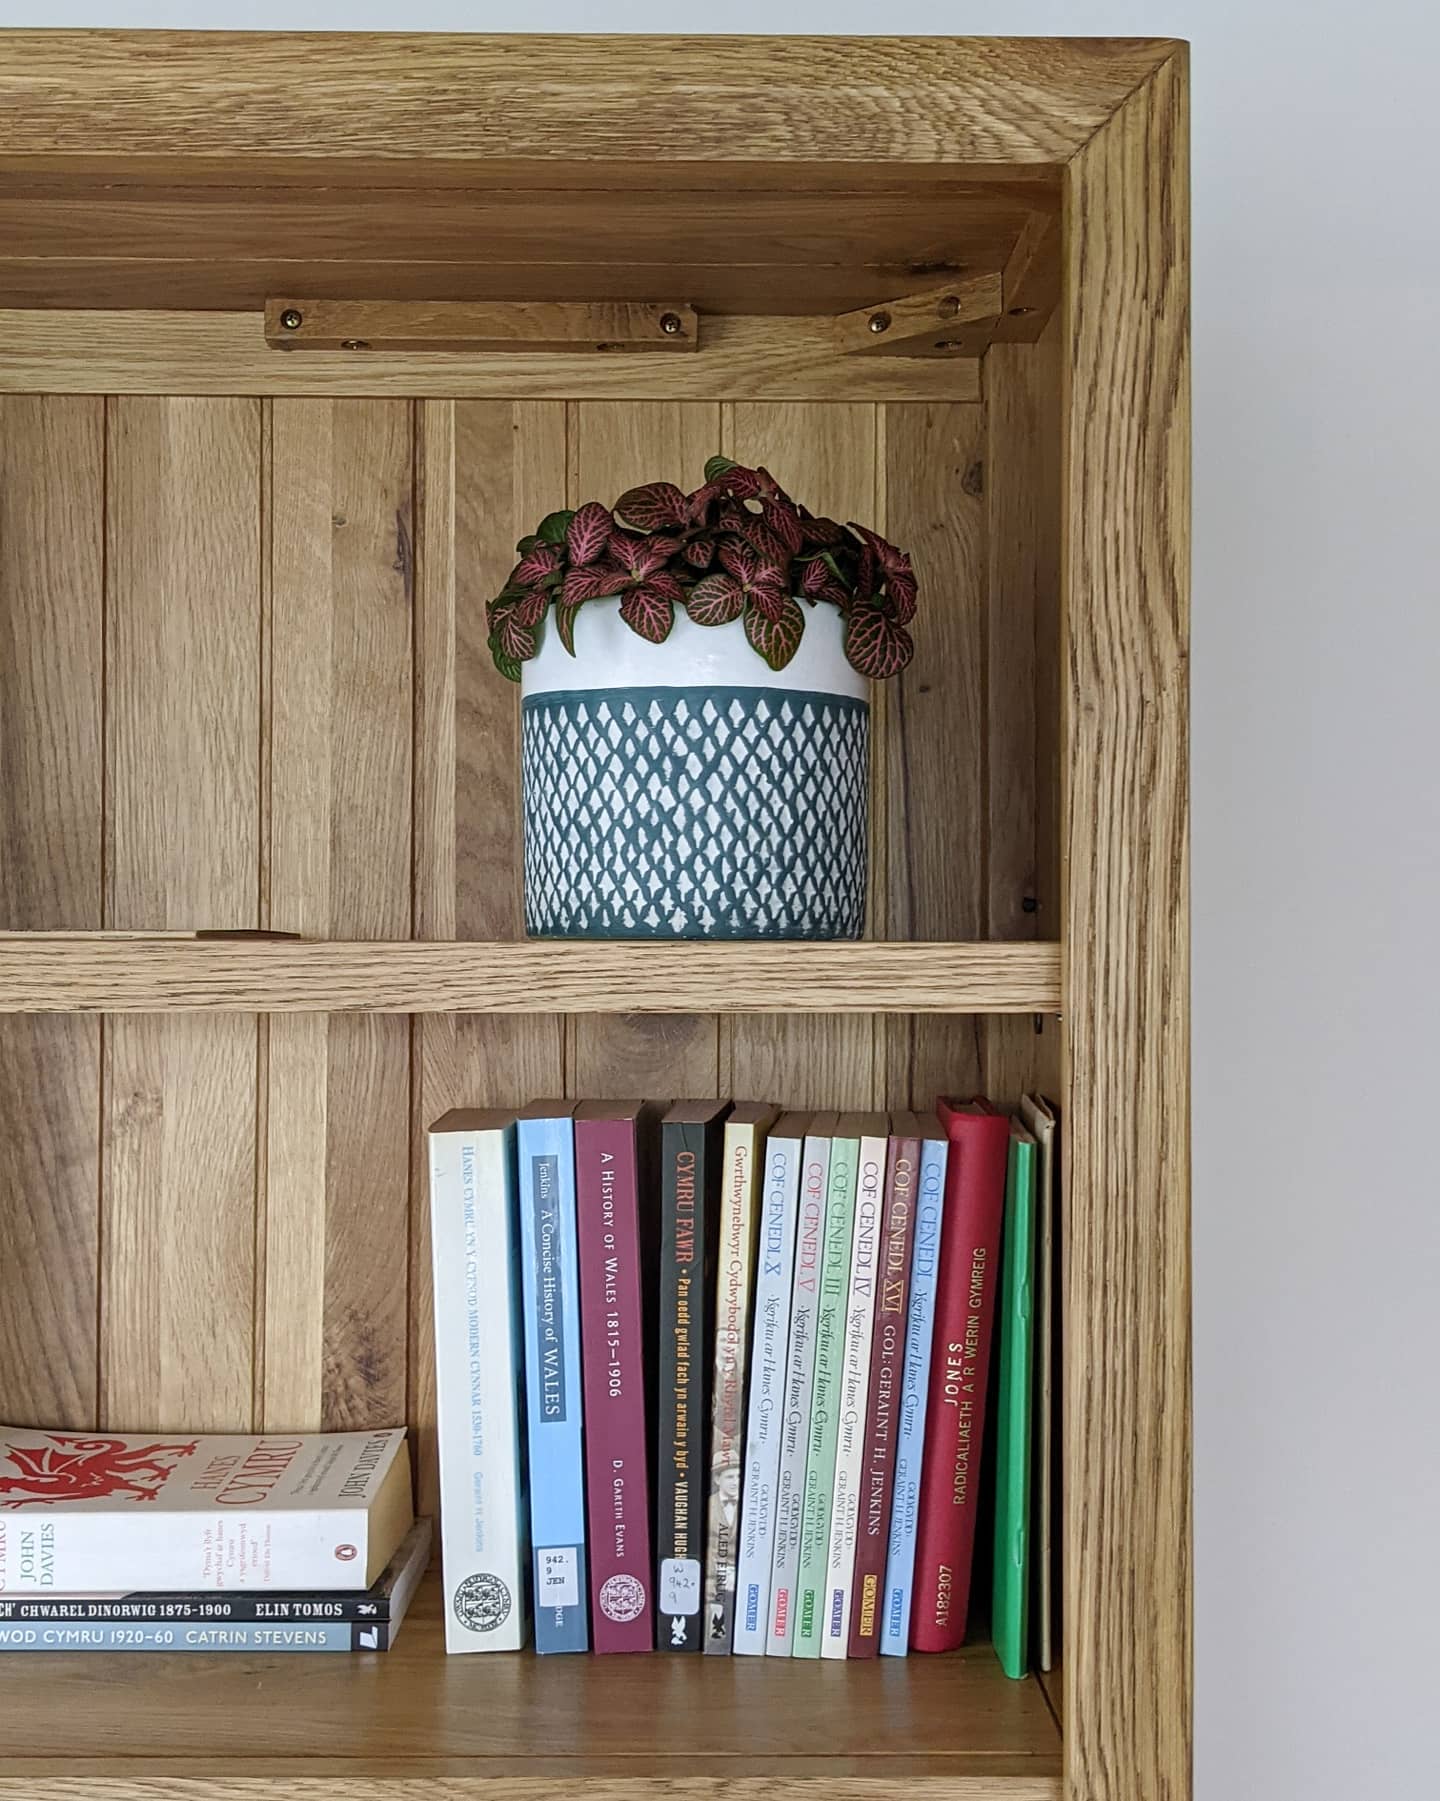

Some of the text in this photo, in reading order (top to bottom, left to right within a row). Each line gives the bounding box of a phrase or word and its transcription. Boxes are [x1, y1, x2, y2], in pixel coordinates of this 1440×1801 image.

[462, 1146, 474, 1185] HANES
[600, 1152, 614, 1163] A
[539, 1162, 550, 1199] Jenkins
[601, 1170, 615, 1227] HISTORY
[727, 1145, 747, 1257] Gwrthwynebwyr
[675, 1151, 695, 1263] CYMRU FAWR
[765, 1153, 787, 1276] COF CENEDL X
[799, 1162, 823, 1293] COF CENEDL V
[916, 1162, 940, 1284] COF CENEDL
[603, 1233, 615, 1250] OF
[825, 1162, 848, 1297] COF CENEDL III
[853, 1161, 879, 1298] COF CENEDL IV
[883, 1159, 911, 1314] COF CENEDL XVI
[466, 1250, 477, 1258] Y
[604, 1257, 618, 1303] WALES
[677, 1278, 691, 1297] Pan
[724, 1259, 743, 1345] Cydwybodol
[541, 1210, 560, 1415] A Concise History of WALES
[677, 1300, 691, 1325] oedd
[674, 1328, 690, 1358] gwlad
[763, 1342, 773, 1357] ar
[792, 1354, 804, 1368] ar
[818, 1353, 830, 1368] ar
[848, 1354, 859, 1369] ar
[910, 1337, 922, 1352] ar
[469, 1360, 481, 1407] CYNNAR
[674, 1387, 687, 1399] yn
[677, 1361, 690, 1384] fach
[761, 1358, 776, 1395] Hanes
[791, 1370, 806, 1408] Hanes
[816, 1370, 832, 1408] Hanes
[846, 1370, 862, 1408] Hanes
[907, 1354, 922, 1391] Hanes
[944, 1343, 963, 1406] JONES
[953, 1248, 986, 1505] RADICALIAETH A R WERIN GYMREIG
[676, 1403, 688, 1437] arwain
[758, 1398, 773, 1441] Cymru
[786, 1410, 802, 1454] Cymru
[812, 1410, 828, 1453] Cymru
[842, 1411, 858, 1453] Cymru
[868, 1325, 896, 1536] GOL: GERAINT H. JENKINS
[903, 1393, 919, 1436] Cymru
[673, 1450, 689, 1469] byd
[721, 1426, 737, 1466] Mawr
[190, 1455, 240, 1491] HANES
[215, 1440, 303, 1504] CYMRU
[338, 1439, 389, 1498] JOHN DAVIES
[749, 1461, 760, 1506] GERAINT
[896, 1458, 908, 1502] GERAINT
[612, 1459, 626, 1558] D. GARETH EVANS
[674, 1481, 689, 1529] VAUGHAN
[780, 1470, 792, 1515] GERAINT
[806, 1470, 818, 1515] GERAINT
[836, 1470, 847, 1515] GERAINT
[20, 1531, 36, 1582] JOHN
[40, 1523, 54, 1585] DAVIES
[545, 1555, 569, 1564] 942.
[546, 1566, 553, 1575] 9
[714, 1523, 729, 1603] ALED EIRUG
[20, 1604, 86, 1616] CHWAREL
[88, 1604, 156, 1616] DINORWIG
[159, 1604, 231, 1616] 1875-1900
[255, 1603, 343, 1616] ELIN TOMOS
[746, 1585, 758, 1631] GOMER
[775, 1589, 788, 1636] GOMER
[802, 1589, 814, 1637] GOMER
[831, 1589, 844, 1637] GOMER
[860, 1575, 877, 1636] GOMER
[890, 1589, 903, 1636] GOMER
[936, 1565, 952, 1626] A182307
[43, 1630, 103, 1643] CYMRU
[110, 1630, 173, 1644] 1920-60
[186, 1631, 327, 1644] CATRIN STEVENS
